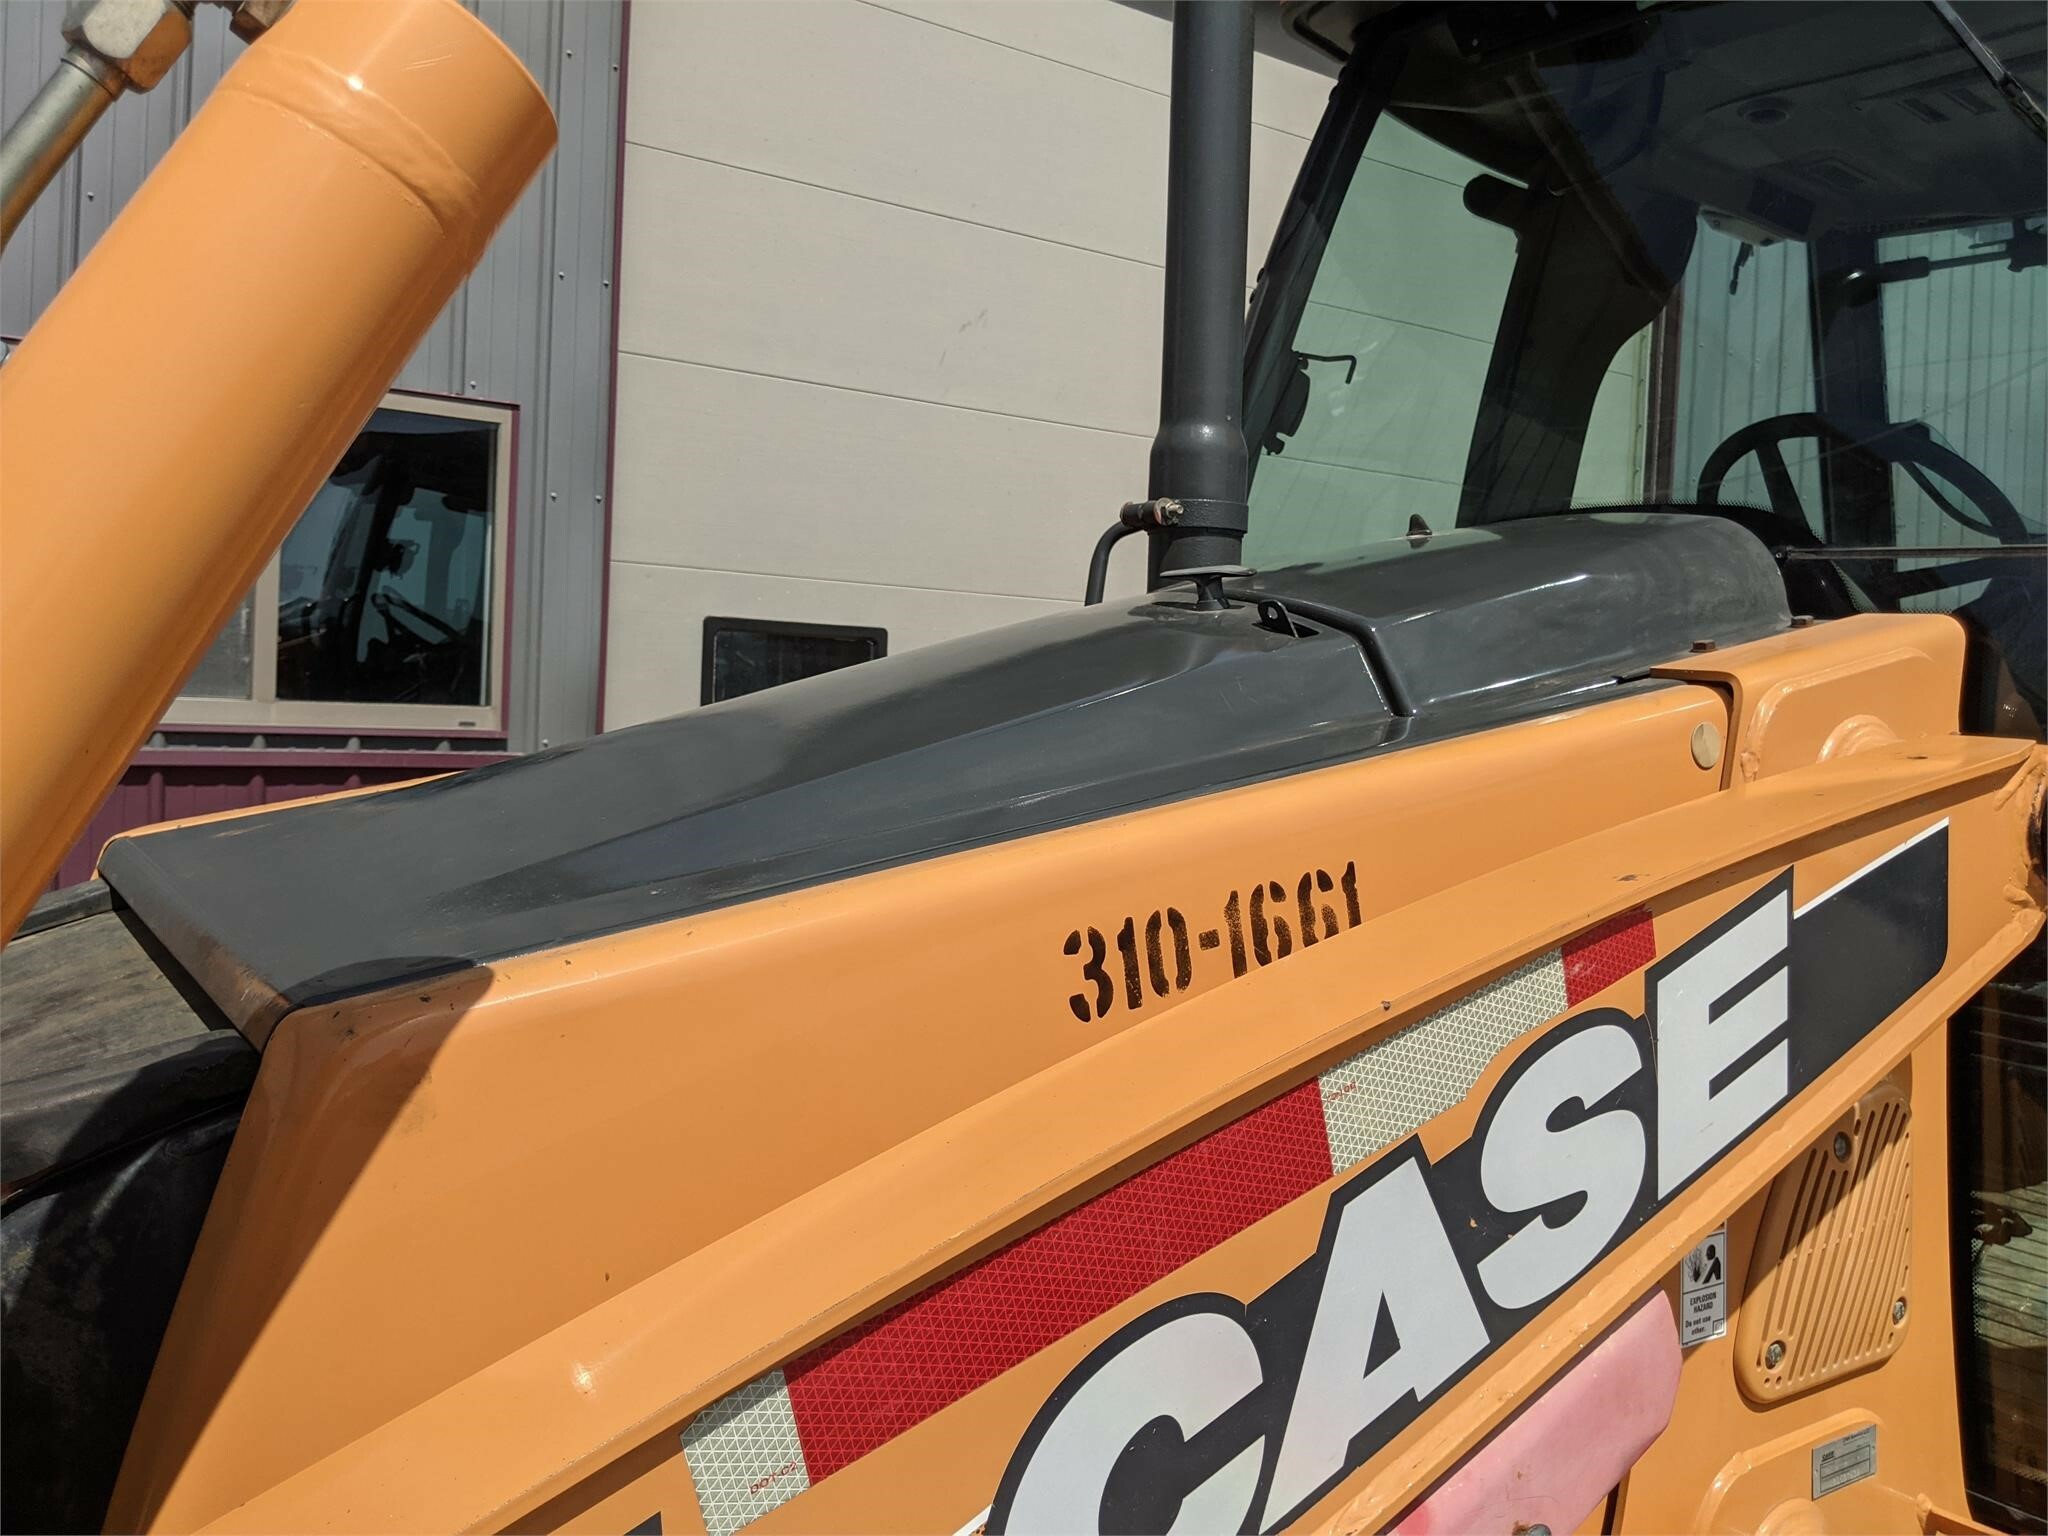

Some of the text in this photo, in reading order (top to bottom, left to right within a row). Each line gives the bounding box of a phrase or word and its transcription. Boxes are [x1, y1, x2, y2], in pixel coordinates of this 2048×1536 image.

[1063, 861, 1362, 1023] 310-1661
[1004, 888, 1789, 1536] CASE
[1690, 1292, 1716, 1305] EXPLOSION
[1693, 1302, 1713, 1313] HAZARD
[751, 1461, 797, 1494] DOT-C2
